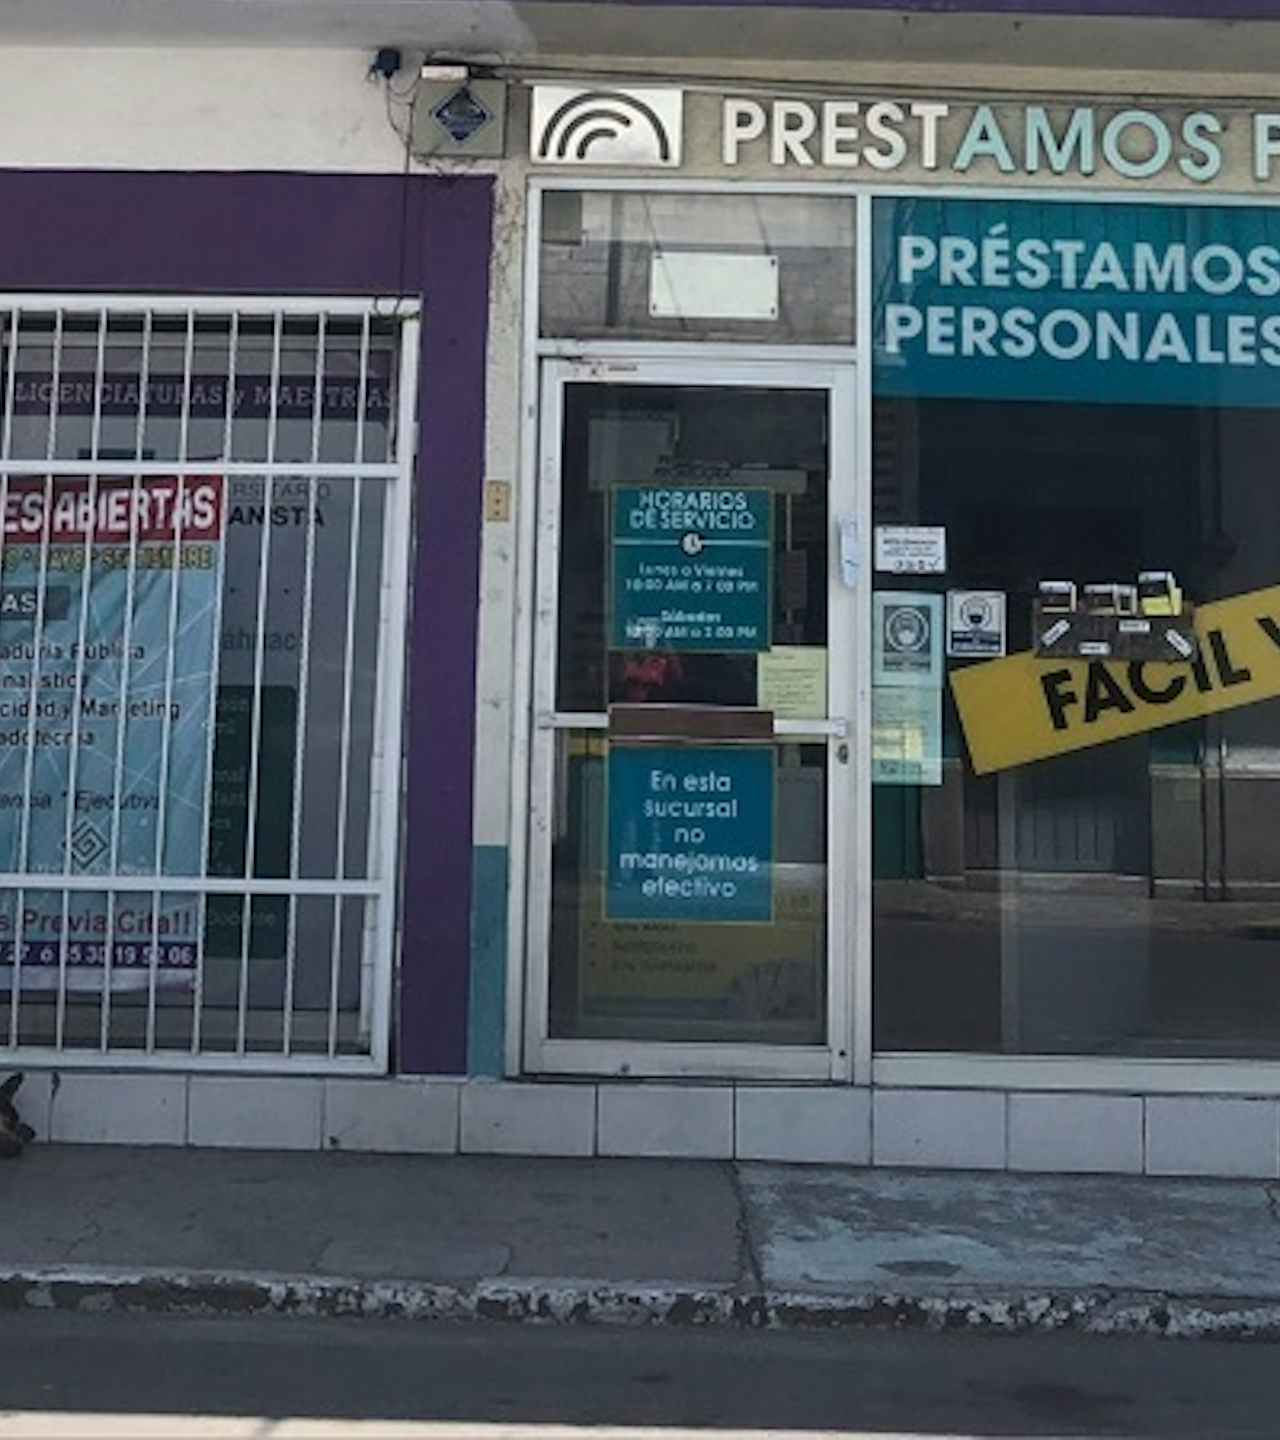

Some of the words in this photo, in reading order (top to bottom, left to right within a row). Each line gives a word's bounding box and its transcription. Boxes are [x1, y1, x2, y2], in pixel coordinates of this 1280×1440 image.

[722, 98, 1223, 182] PRESTAMOS
[52, 485, 218, 533] ABIERTAS
[639, 491, 747, 510] HORARIOS
[629, 510, 658, 529] DE
[660, 510, 756, 530] SERVICIO
[80, 700, 181, 721] Mareting
[651, 769, 677, 792] En
[683, 770, 732, 792] esta
[643, 799, 738, 818] sucursal
[673, 826, 706, 844] no
[641, 876, 738, 898] efectivo
[22, 911, 107, 934] Previa
[115, 946, 136, 964] 19
[170, 946, 194, 964] 06
